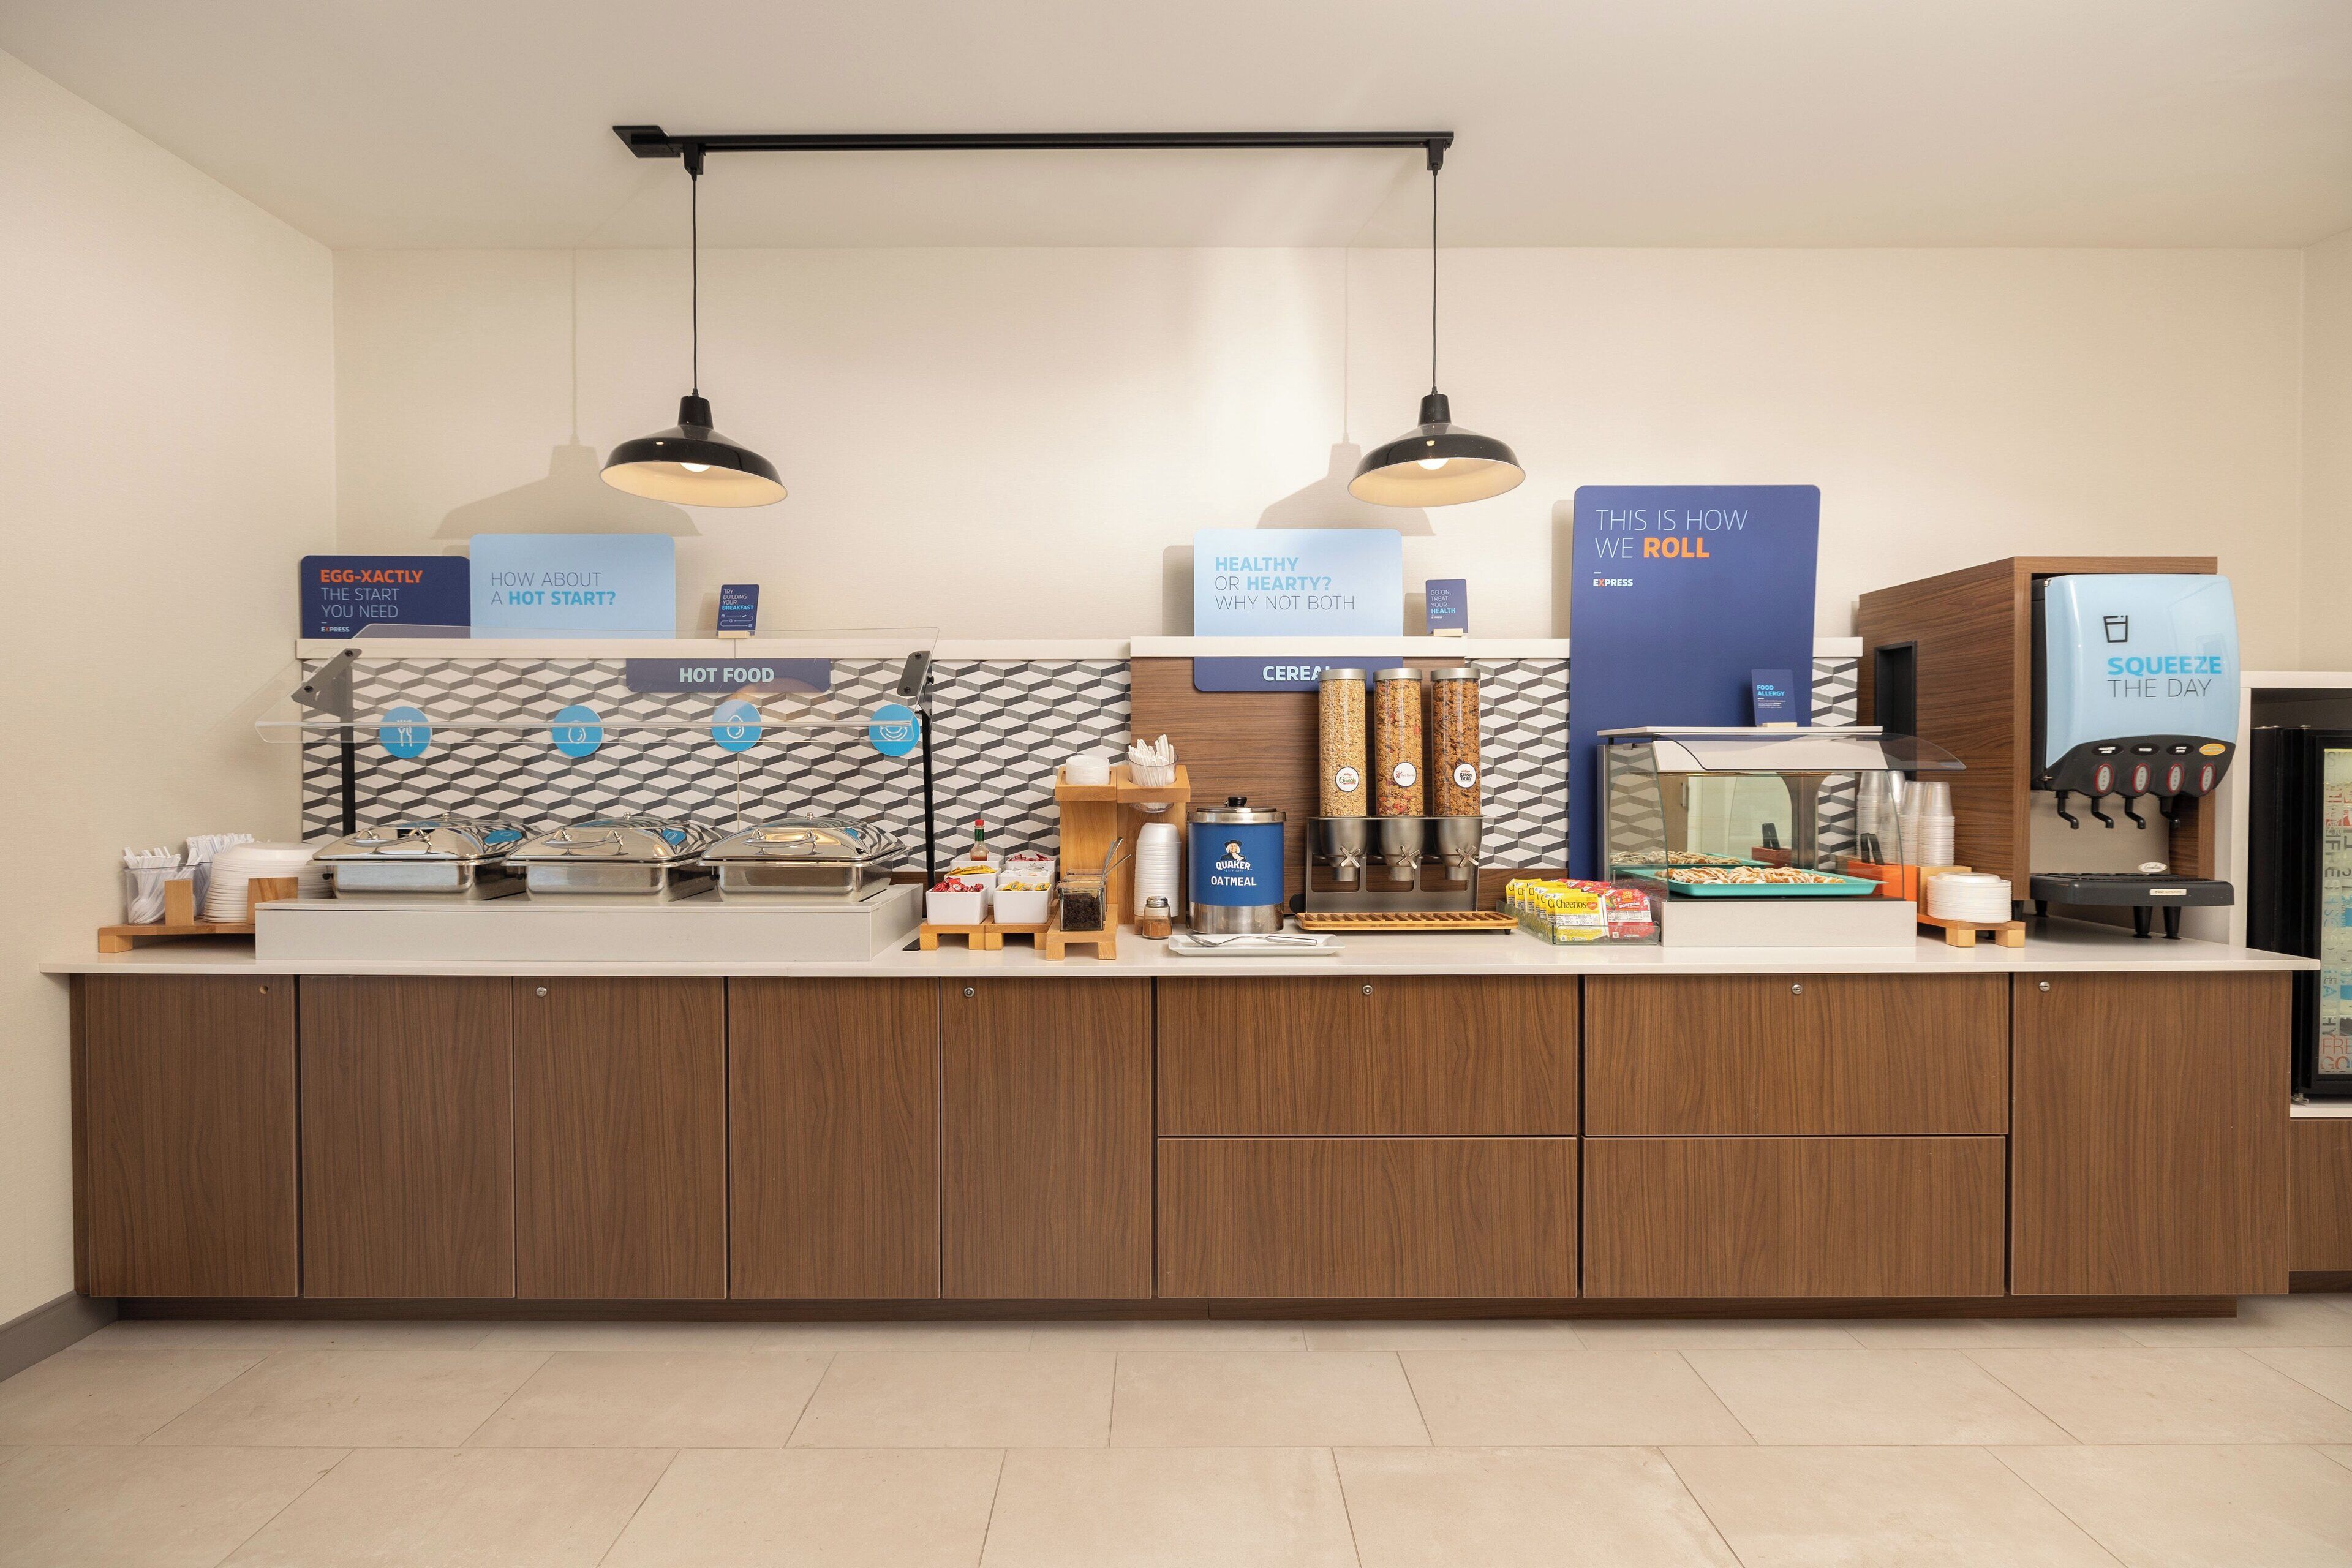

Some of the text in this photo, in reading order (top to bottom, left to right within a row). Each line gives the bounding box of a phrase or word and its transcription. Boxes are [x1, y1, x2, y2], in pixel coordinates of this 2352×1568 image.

[1596, 510, 1748, 531] THIS IS HOW
[1595, 537, 1710, 559] WE ROLL
[1215, 557, 1299, 571] HEALTHY
[320, 570, 423, 583] EGG-XACTLY
[491, 572, 601, 587] HOW ABOUT
[1215, 576, 1332, 591] OR HEARTY?
[321, 587, 399, 601] THE START
[491, 590, 616, 605] A HOT START?
[1215, 595, 1354, 610] WHY NOT BOTH
[321, 605, 398, 618] YOU NEED
[1262, 666, 1330, 681] CEREA
[2108, 656, 2222, 676] SQUEEZE
[680, 668, 774, 682] HOT FOOD
[2107, 679, 2212, 697] THE DAY
[1216, 861, 1251, 870] QUAKER
[1211, 876, 1257, 886] OATMEAL
[1556, 899, 1586, 908] Cheerios
